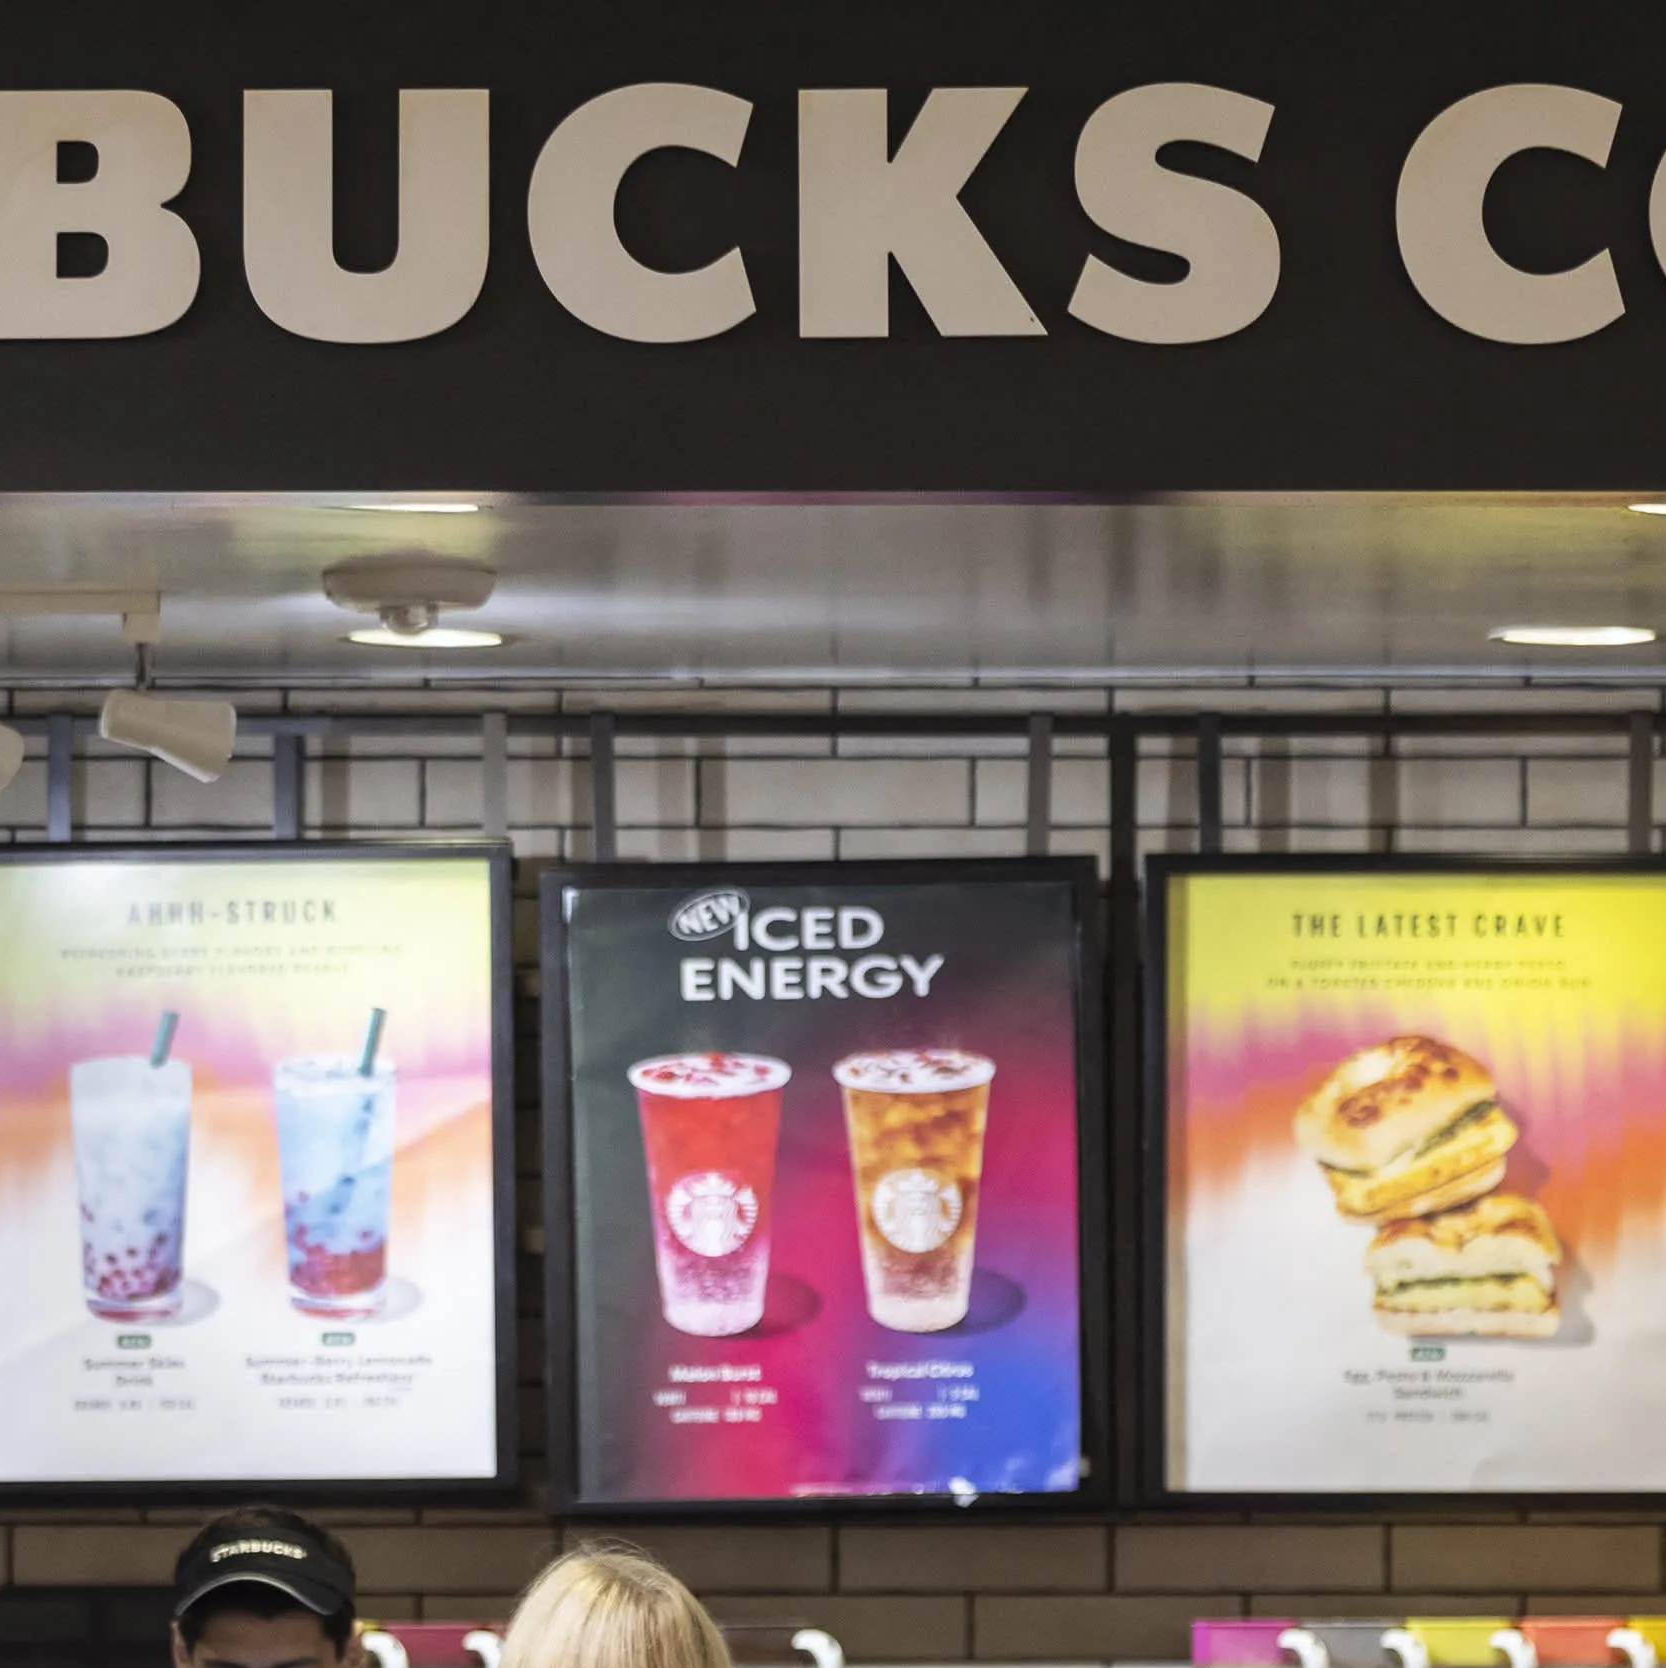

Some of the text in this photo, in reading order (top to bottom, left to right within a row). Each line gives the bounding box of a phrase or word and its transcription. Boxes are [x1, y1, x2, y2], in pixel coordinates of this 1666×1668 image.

[676, 892, 741, 936] NEW
[733, 907, 884, 951] ICED
[1293, 914, 1566, 938] THE LATEST CRAVE
[680, 956, 944, 1000] ENERGY
[209, 1539, 307, 1563] STARBUCKS
